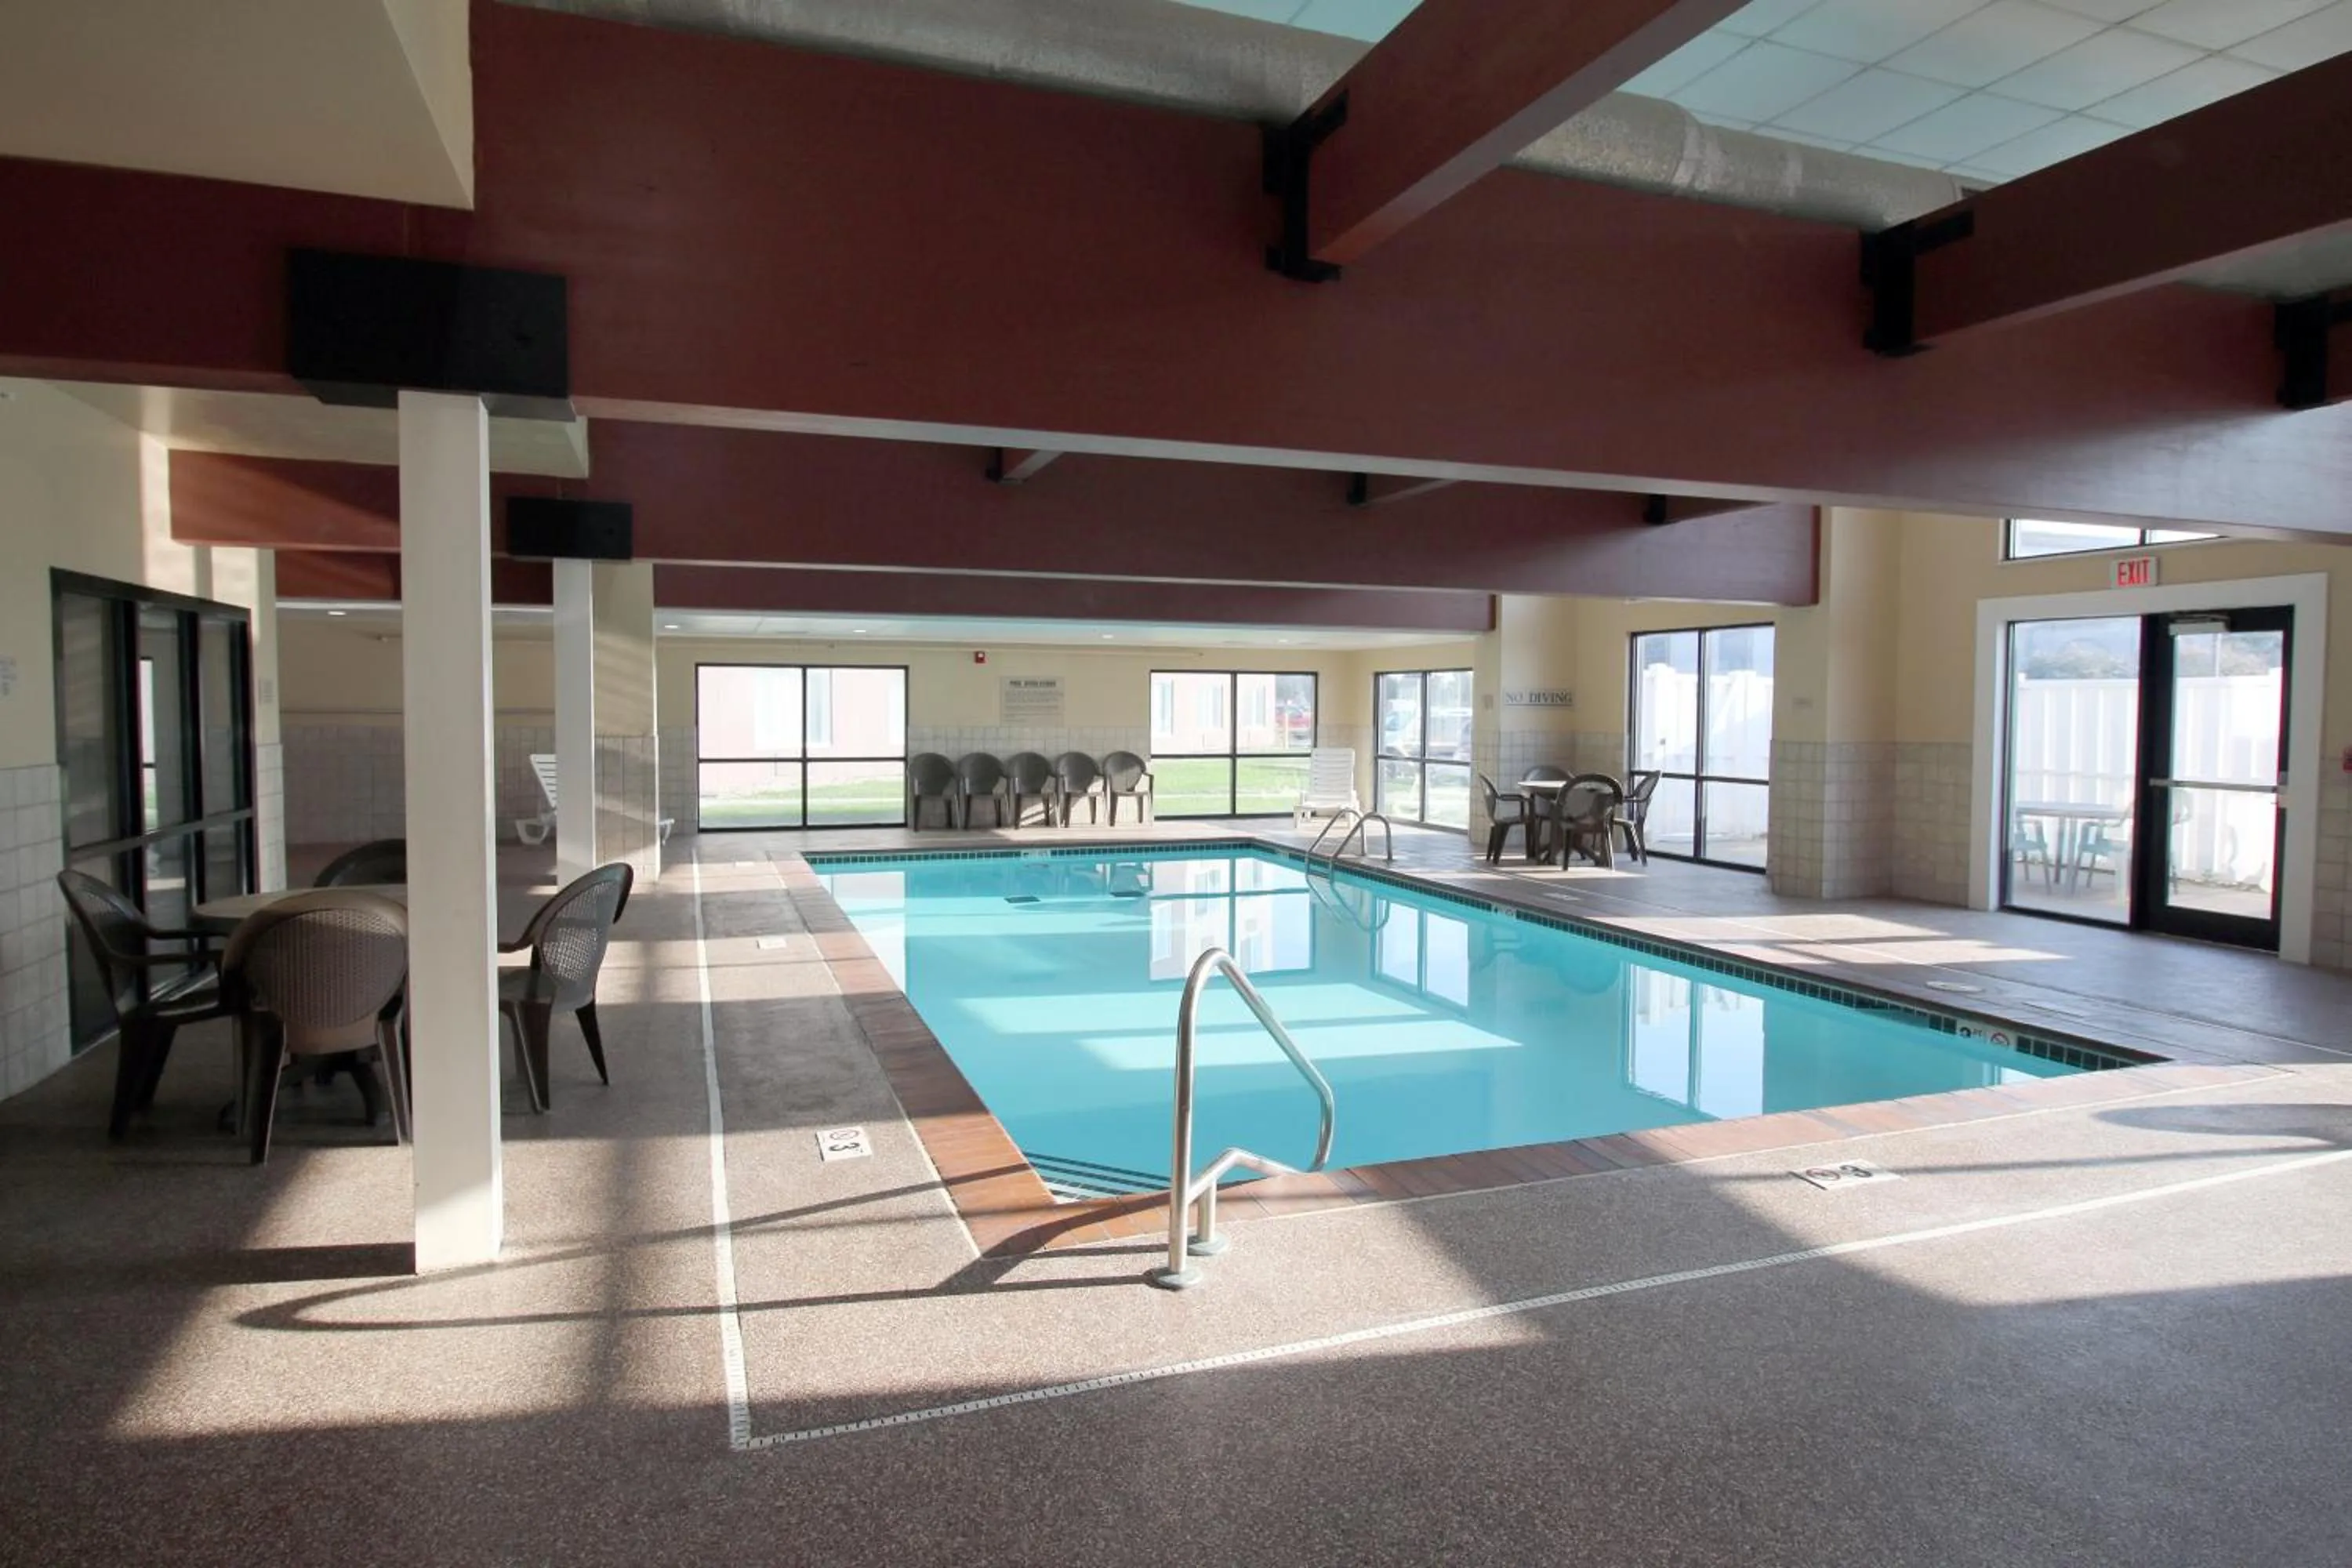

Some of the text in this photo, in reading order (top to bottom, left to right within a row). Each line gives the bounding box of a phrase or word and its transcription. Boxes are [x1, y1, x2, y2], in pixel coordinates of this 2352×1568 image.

[2118, 560, 2151, 586] EXIT
[1505, 691, 1573, 703] NO DIVING
